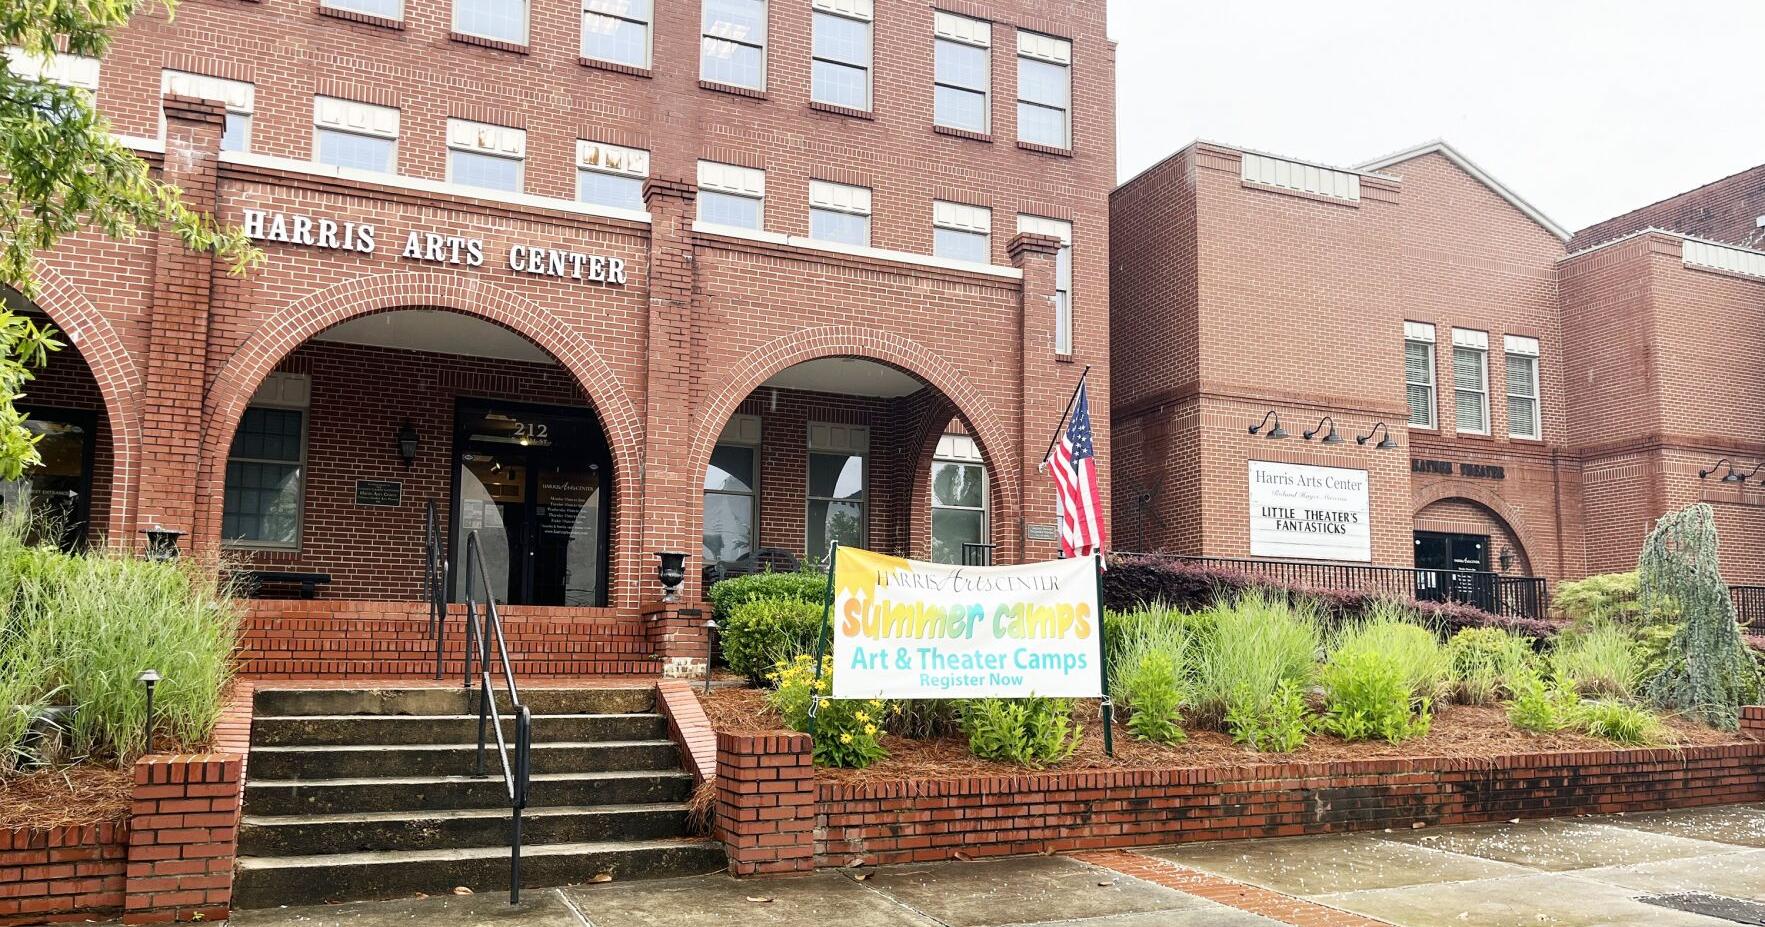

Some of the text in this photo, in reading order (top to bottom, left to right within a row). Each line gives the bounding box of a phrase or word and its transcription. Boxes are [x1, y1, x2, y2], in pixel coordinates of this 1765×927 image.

[243, 208, 628, 286] HARRIS ARTS CENTER
[514, 422, 548, 438] 212
[1256, 470, 1363, 491] Harris Arts Center
[1262, 506, 1358, 523] LITTLE THEATER'S
[1276, 520, 1346, 535] FANTASTICKS
[877, 568, 1060, 594] HARRIS Arts CENTER
[842, 599, 1091, 640] summer camps
[851, 647, 1087, 675] Art & Theater Camps
[920, 673, 1023, 689] Register Now
